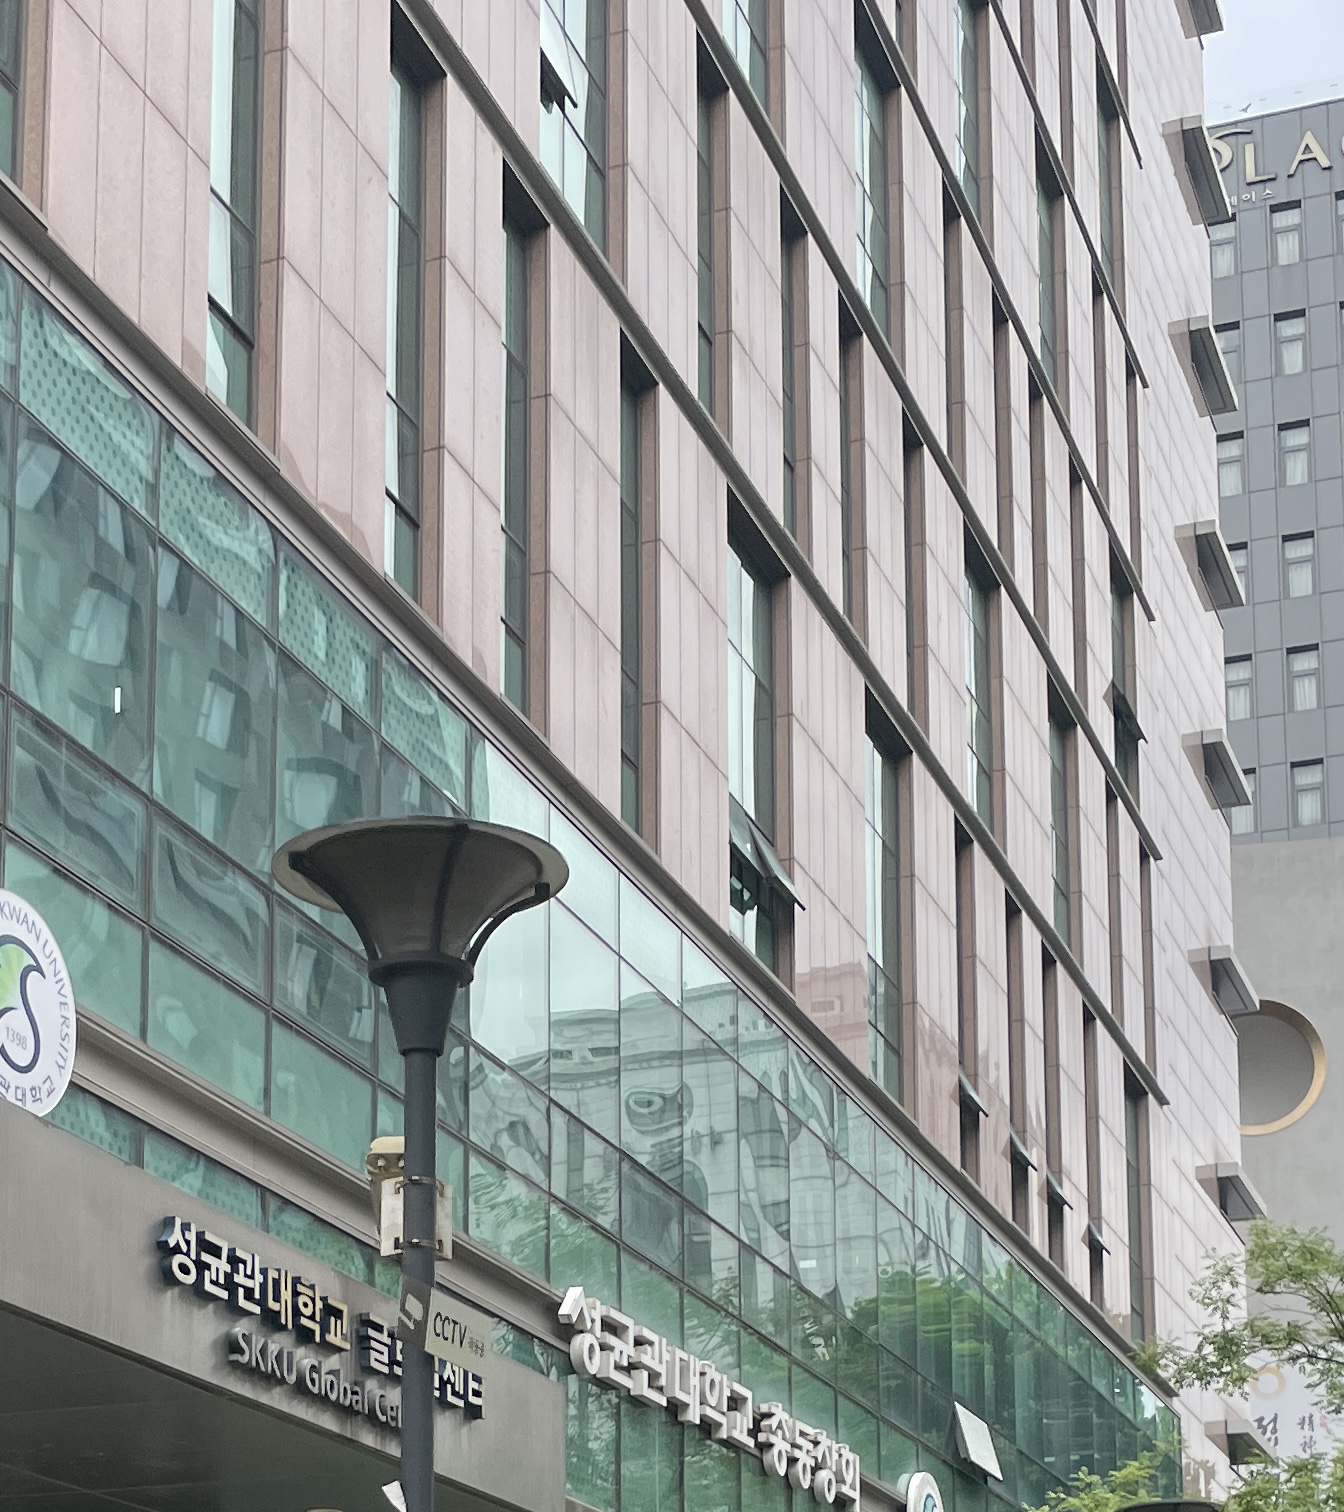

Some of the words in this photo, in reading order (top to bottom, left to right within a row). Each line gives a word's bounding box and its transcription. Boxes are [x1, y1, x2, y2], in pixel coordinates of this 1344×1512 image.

[5, 1026, 28, 1051] 1398
[42, 938, 71, 1078] UNIVERSITY
[158, 1216, 351, 1351] 성균관대학교
[433, 1311, 468, 1349] CCTV
[229, 1328, 297, 1385] SKKU
[304, 1357, 369, 1416] Global
[558, 1286, 755, 1450] 성균관대학교
